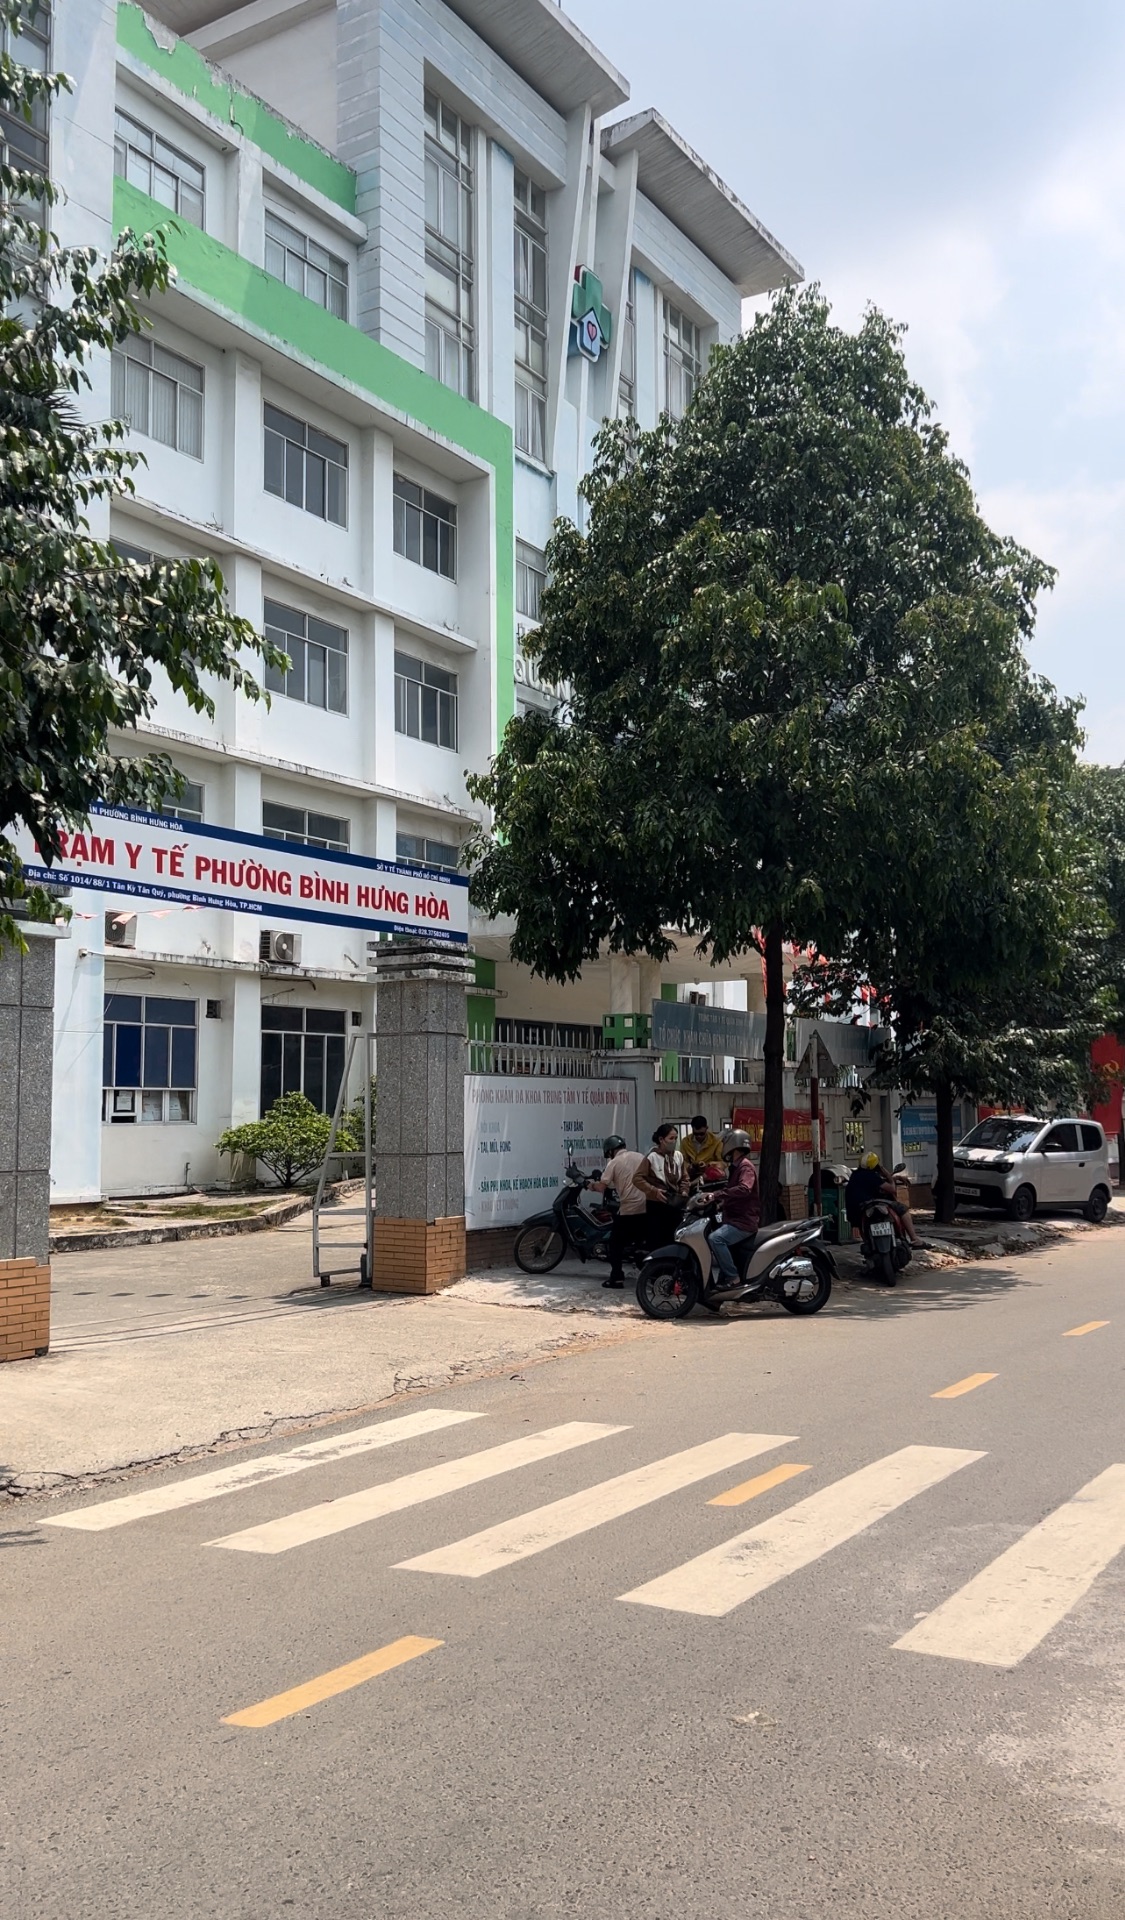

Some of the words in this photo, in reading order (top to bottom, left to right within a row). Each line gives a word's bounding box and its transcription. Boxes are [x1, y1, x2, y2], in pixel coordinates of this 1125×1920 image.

[99, 807, 129, 821] PHƯỜNG
[130, 813, 148, 825] BÌNH
[150, 817, 169, 829] HƯNG
[169, 819, 184, 832] HÒA
[35, 829, 115, 867] RẠM
[124, 842, 143, 869] Y
[152, 843, 189, 878] TẾ
[195, 855, 292, 896] PHƯỜNG
[300, 871, 349, 905] BÌNH
[357, 885, 409, 915] HƯNG
[415, 892, 450, 921] HÒA
[389, 864, 396, 873] TẾ
[413, 868, 423, 878] PHỐ
[28, 868, 41, 879] Địa
[42, 870, 57, 881] chỉ:
[58, 872, 69, 882] Số
[112, 881, 126, 891] Tân
[137, 885, 150, 895] Tân
[167, 890, 191, 902] phường
[192, 893, 207, 903] Bình
[208, 897, 224, 907] Hưng
[240, 902, 263, 912] TP.HCM
[472, 1088, 495, 1105] PHÒNG
[495, 1086, 514, 1104] KHÁM
[515, 1090, 525, 1104] ĐA
[525, 1090, 542, 1104] KHOA
[543, 1090, 562, 1105] TRUNG
[563, 1087, 576, 1104] TÂM
[582, 1086, 589, 1104] TẾ
[590, 1087, 605, 1107] QUẬN
[619, 1088, 630, 1105] TÂN
